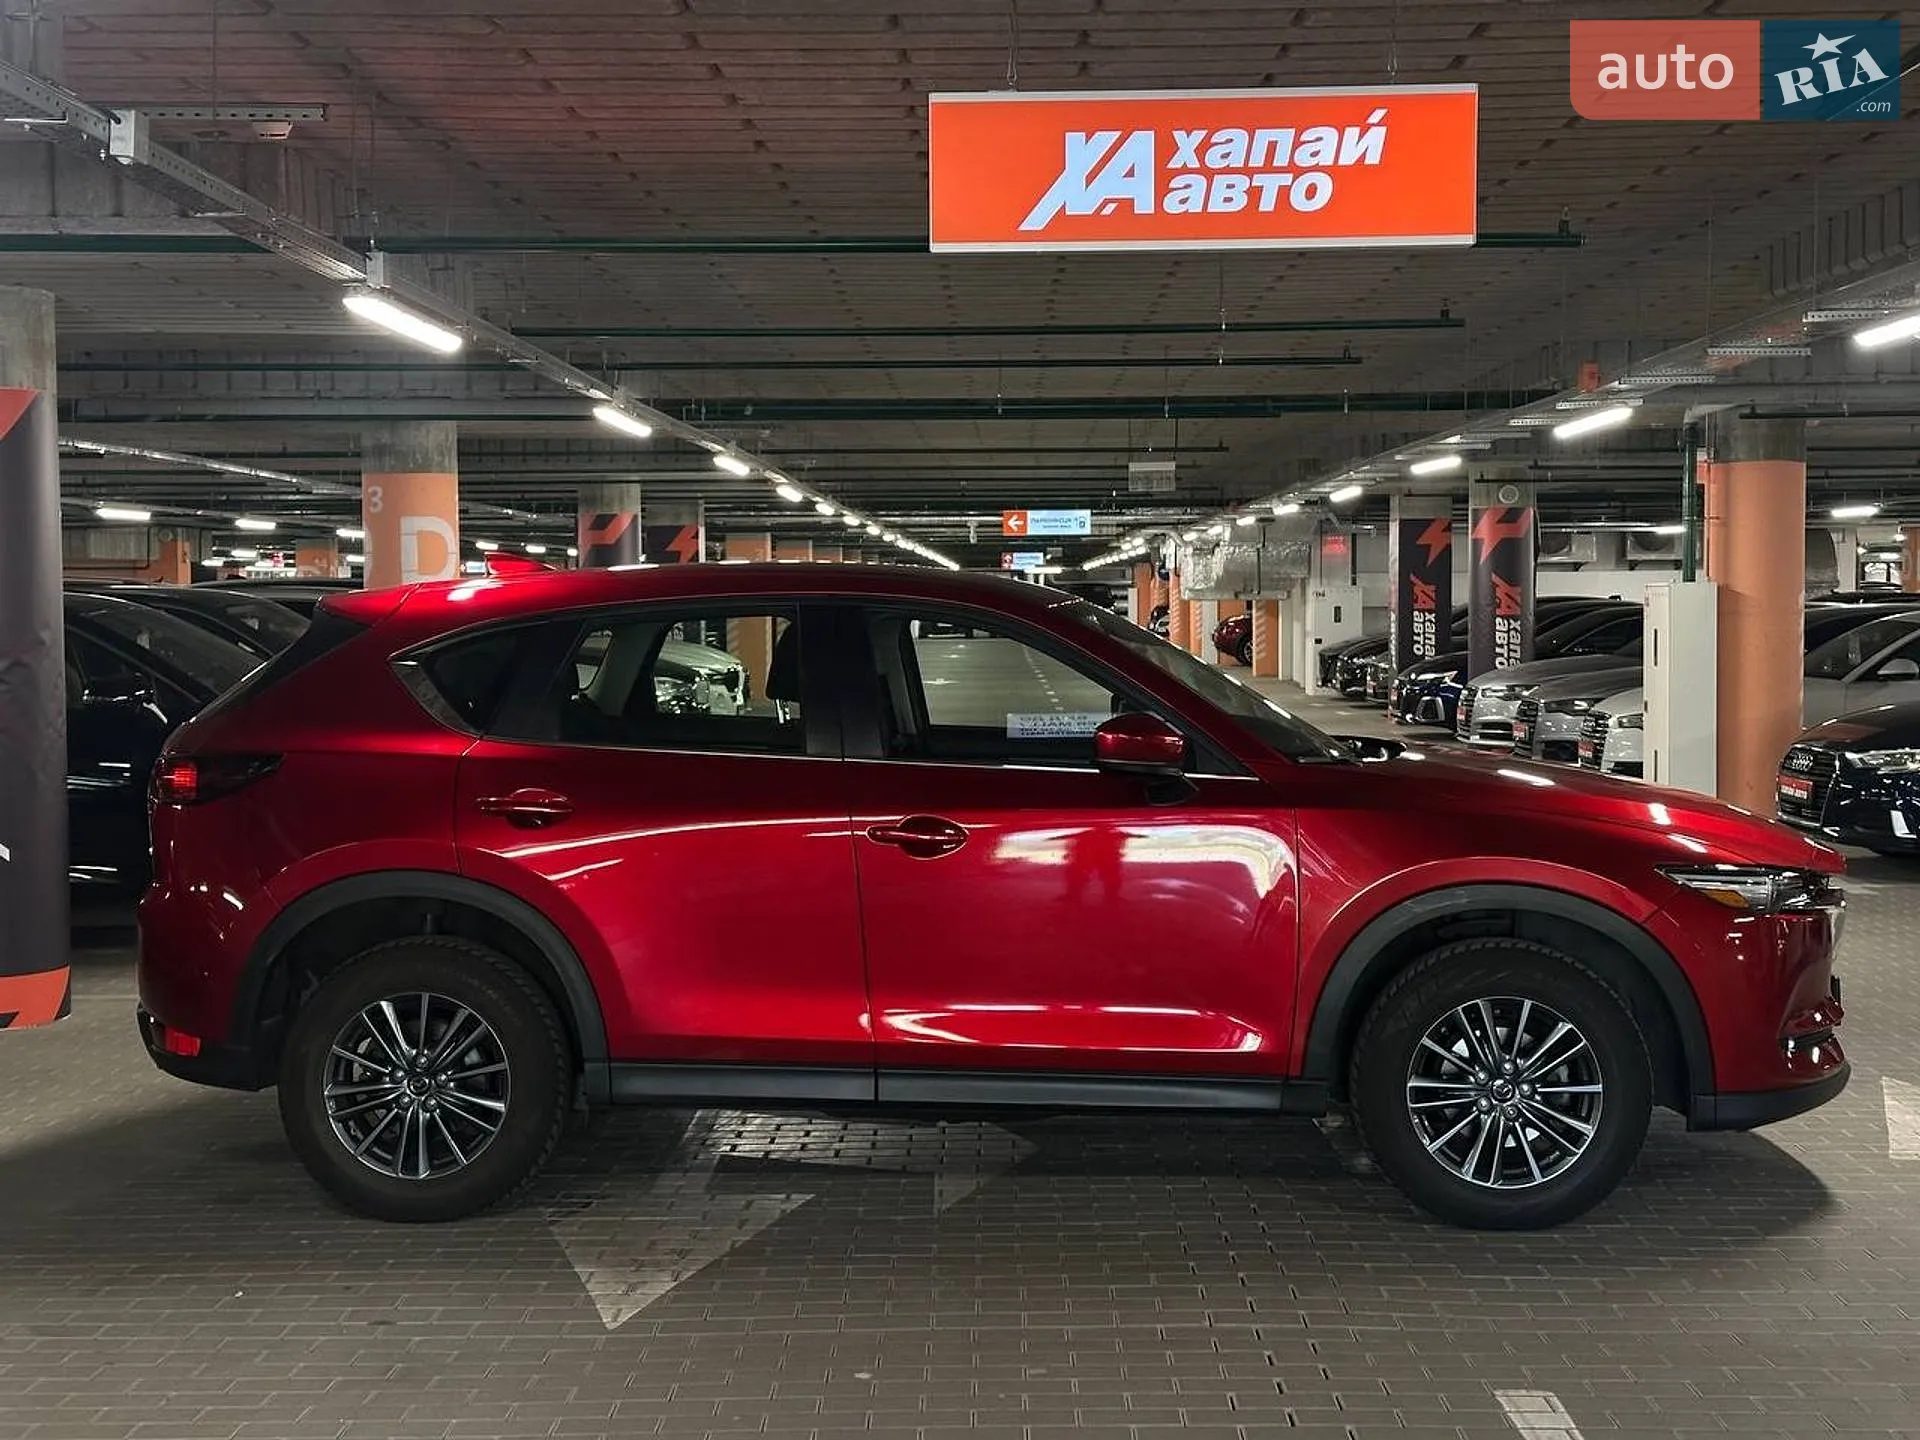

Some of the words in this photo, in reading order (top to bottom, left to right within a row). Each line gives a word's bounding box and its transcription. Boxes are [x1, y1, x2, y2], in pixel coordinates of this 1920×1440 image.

[1166, 107, 1390, 169] хапай
[1162, 172, 1334, 215] авто
[367, 485, 383, 513] 3
[401, 515, 458, 585] D
[1412, 610, 1425, 656] авто
[1495, 616, 1509, 670] авто
